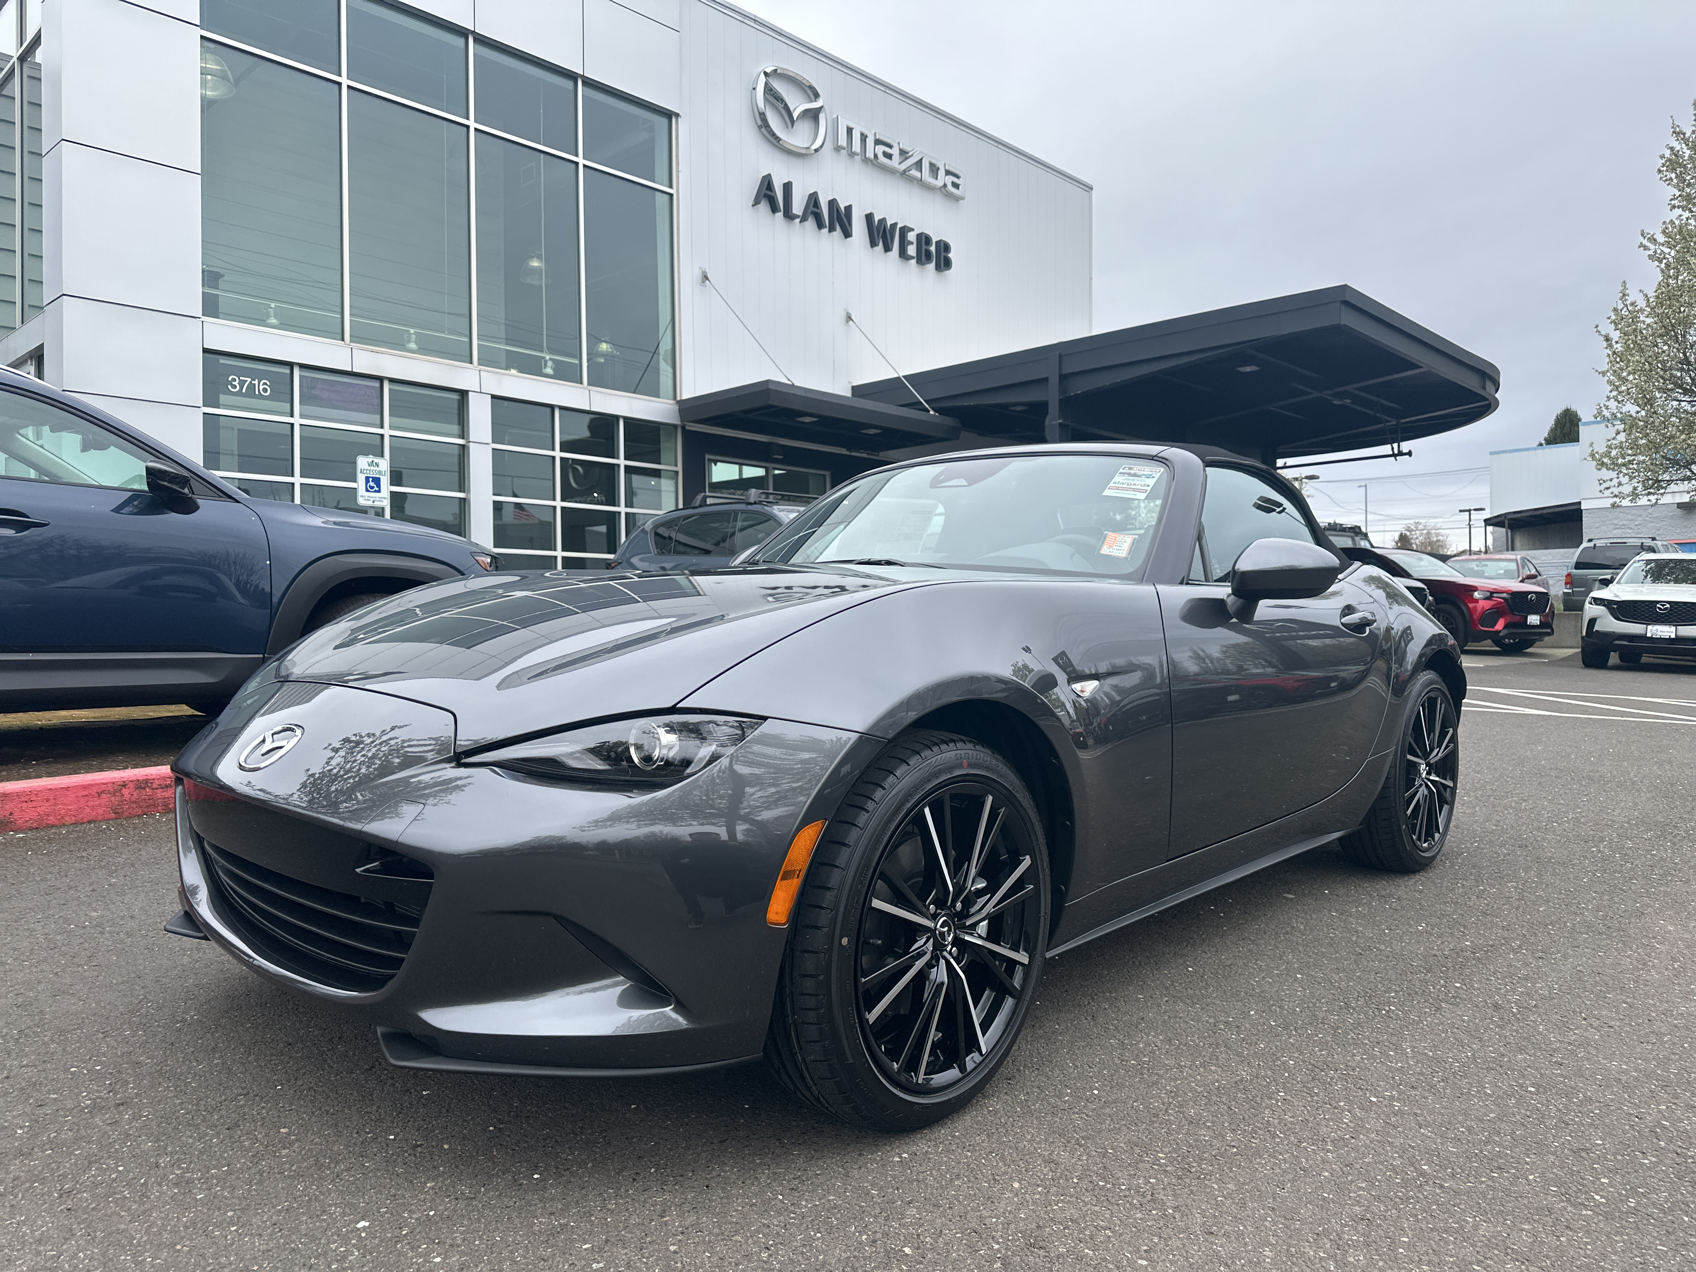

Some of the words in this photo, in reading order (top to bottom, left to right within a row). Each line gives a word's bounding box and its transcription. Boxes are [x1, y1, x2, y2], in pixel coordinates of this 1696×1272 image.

[832, 114, 965, 201] mazda
[752, 172, 853, 239] ALAN
[864, 211, 954, 273] WEBB
[227, 375, 271, 396] 3716
[359, 468, 387, 477] ACCESSIBLE
[367, 460, 380, 468] VAN
